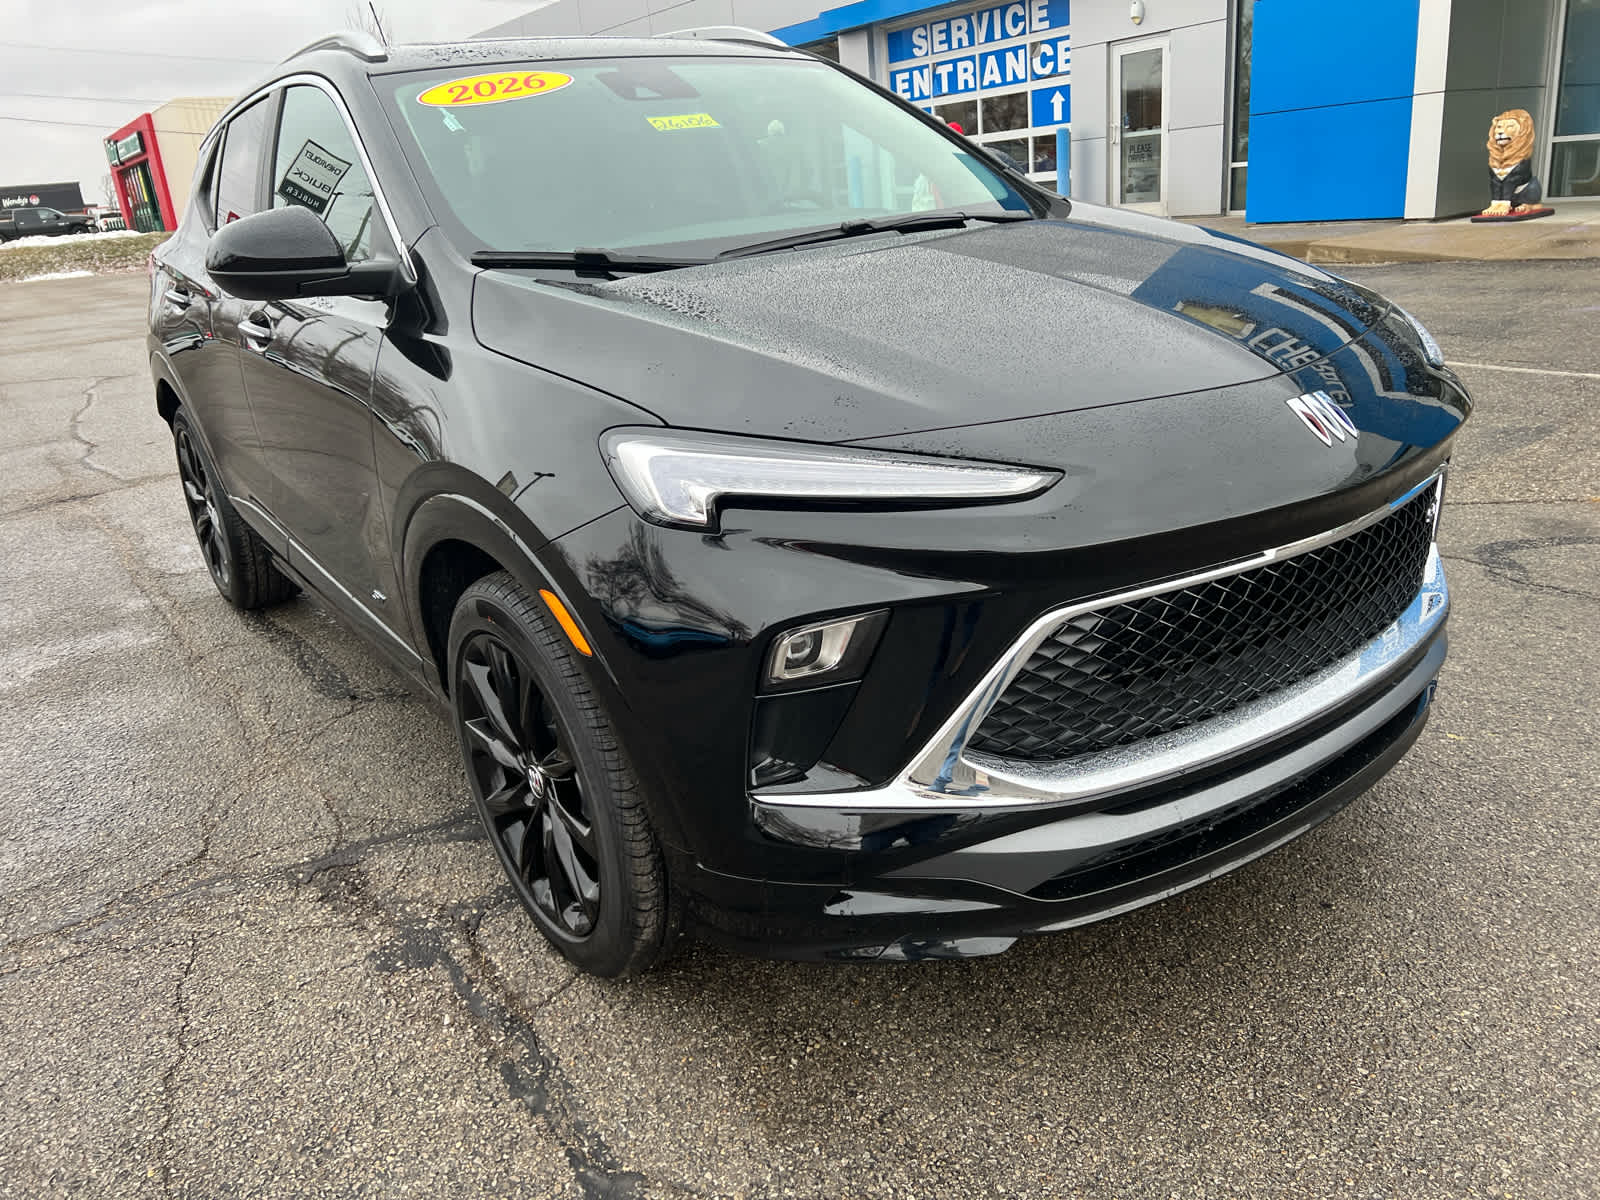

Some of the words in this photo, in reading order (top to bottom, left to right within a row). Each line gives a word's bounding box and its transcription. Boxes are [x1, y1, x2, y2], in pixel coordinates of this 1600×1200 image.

[911, 0, 1050, 57] SERVICE
[447, 73, 547, 103] 2026
[895, 41, 1071, 100] ENTRANCE
